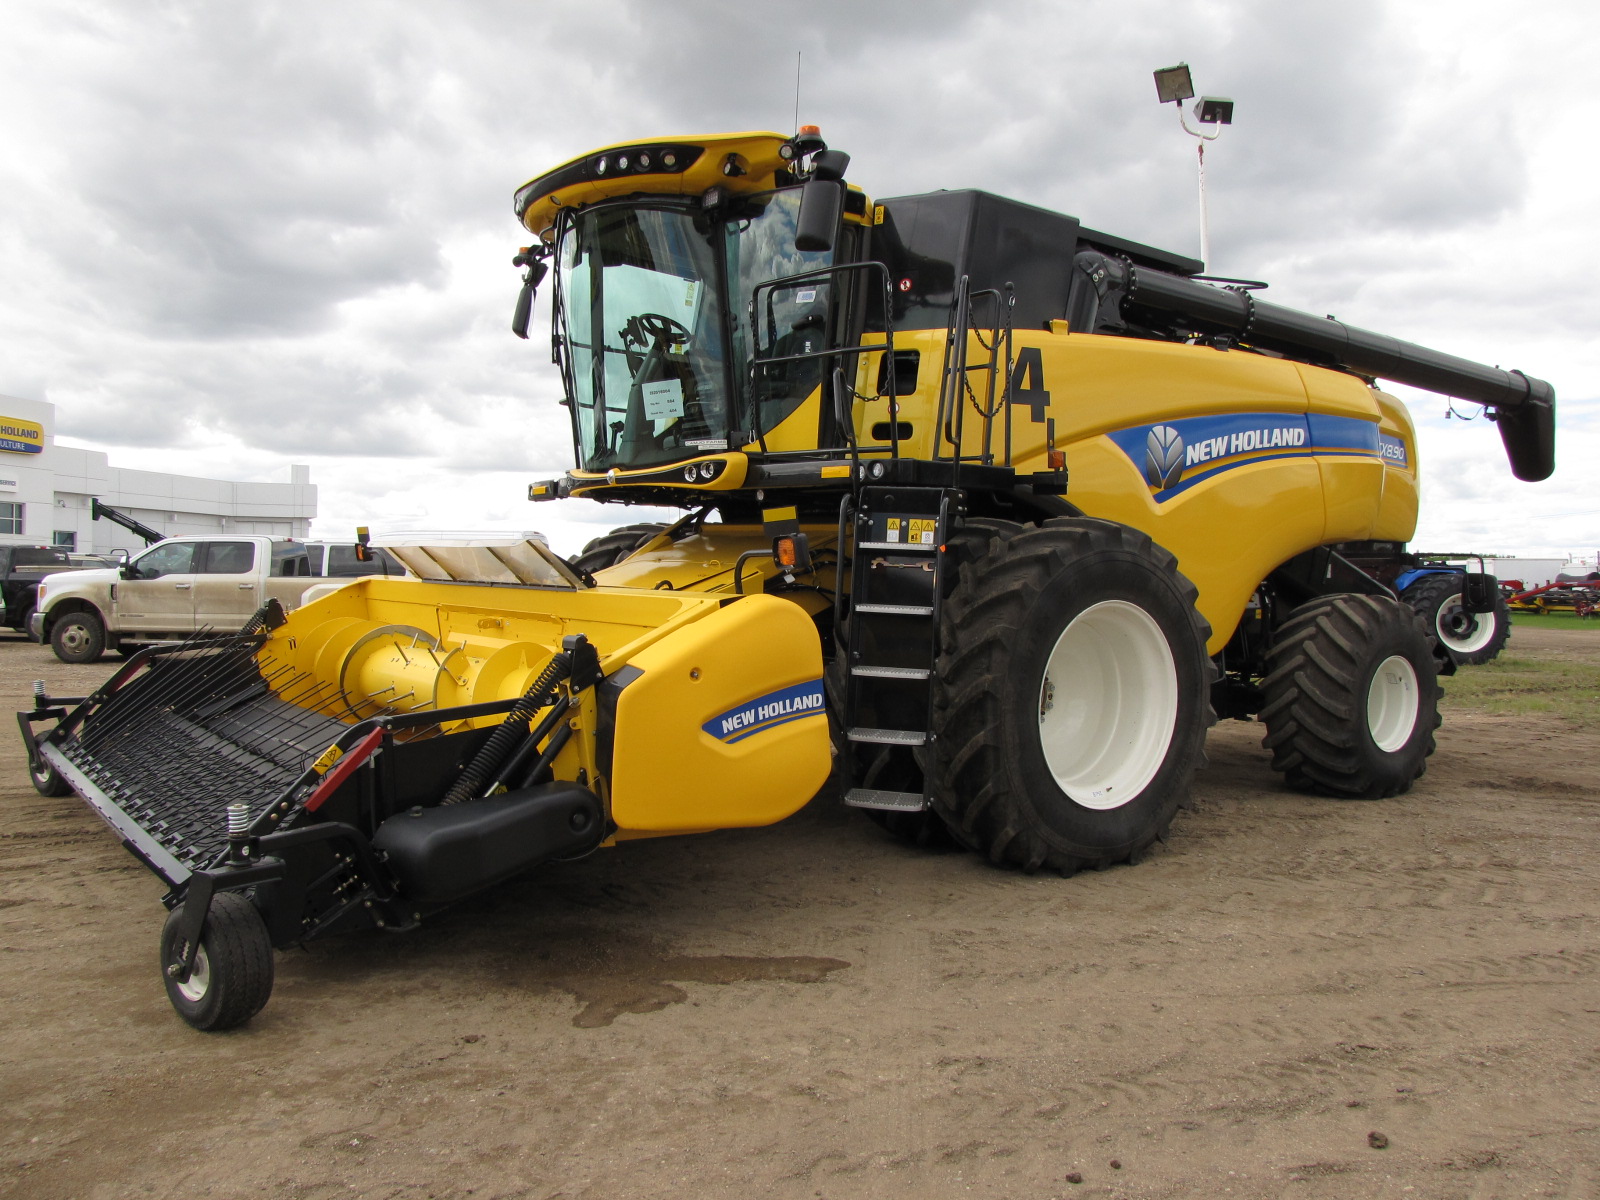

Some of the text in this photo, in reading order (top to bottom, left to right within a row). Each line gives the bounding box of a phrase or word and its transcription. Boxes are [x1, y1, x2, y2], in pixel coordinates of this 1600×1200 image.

[1011, 347, 1050, 423] 4
[0, 425, 39, 440] HOLLAND
[1185, 428, 1305, 467] NEW HOLLAND
[721, 693, 823, 734] NEW HOLLAND
